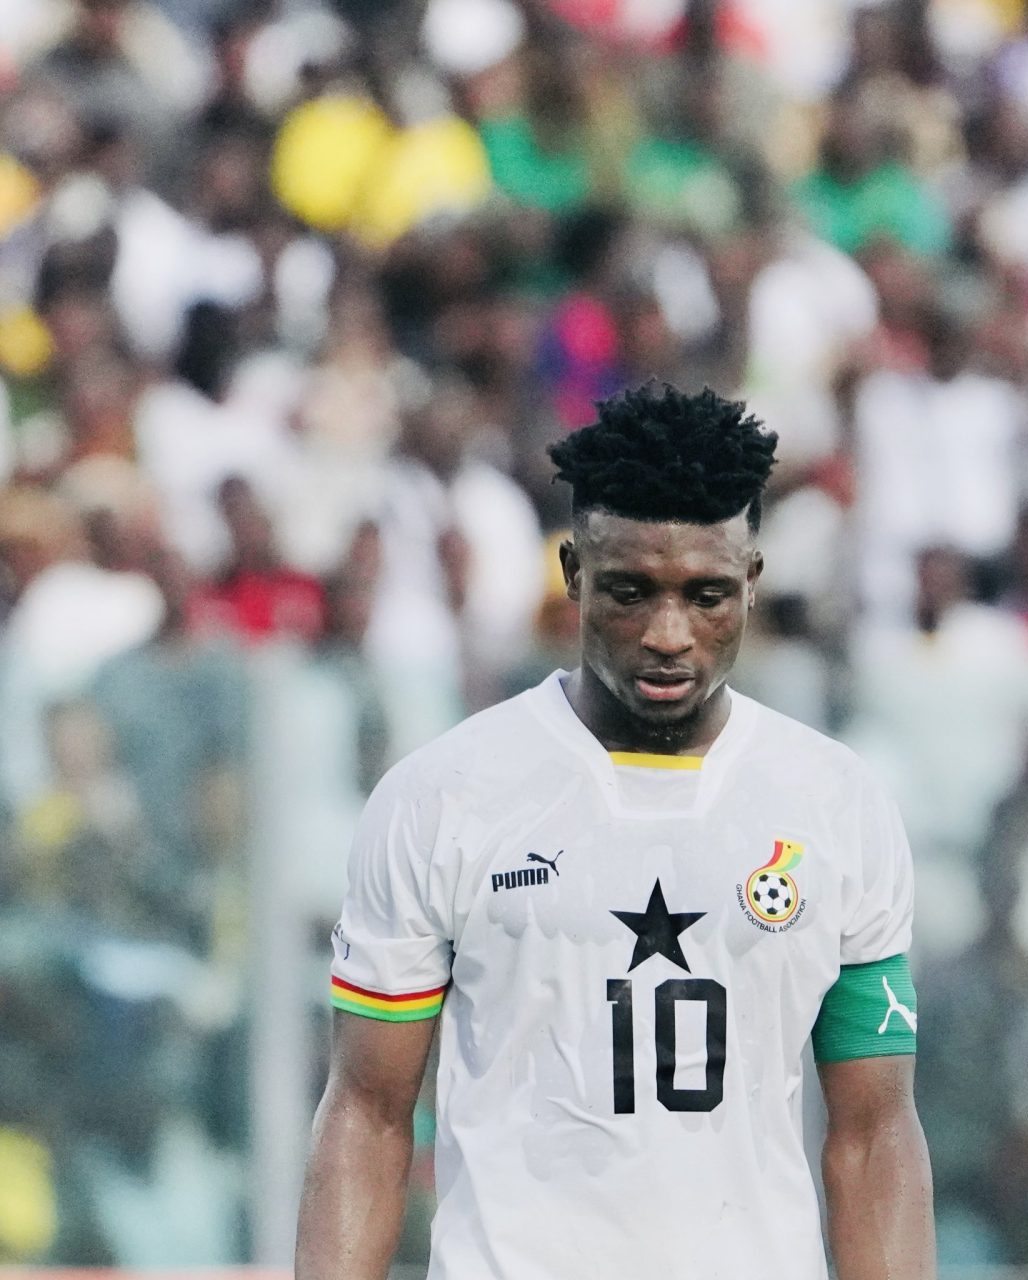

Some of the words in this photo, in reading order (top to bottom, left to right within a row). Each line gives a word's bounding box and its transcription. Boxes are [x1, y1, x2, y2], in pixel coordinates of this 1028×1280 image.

[491, 868, 549, 892] PUMA
[735, 883, 747, 911] GHANA
[744, 910, 777, 933] FOOTBALL
[606, 979, 727, 1114] 10
